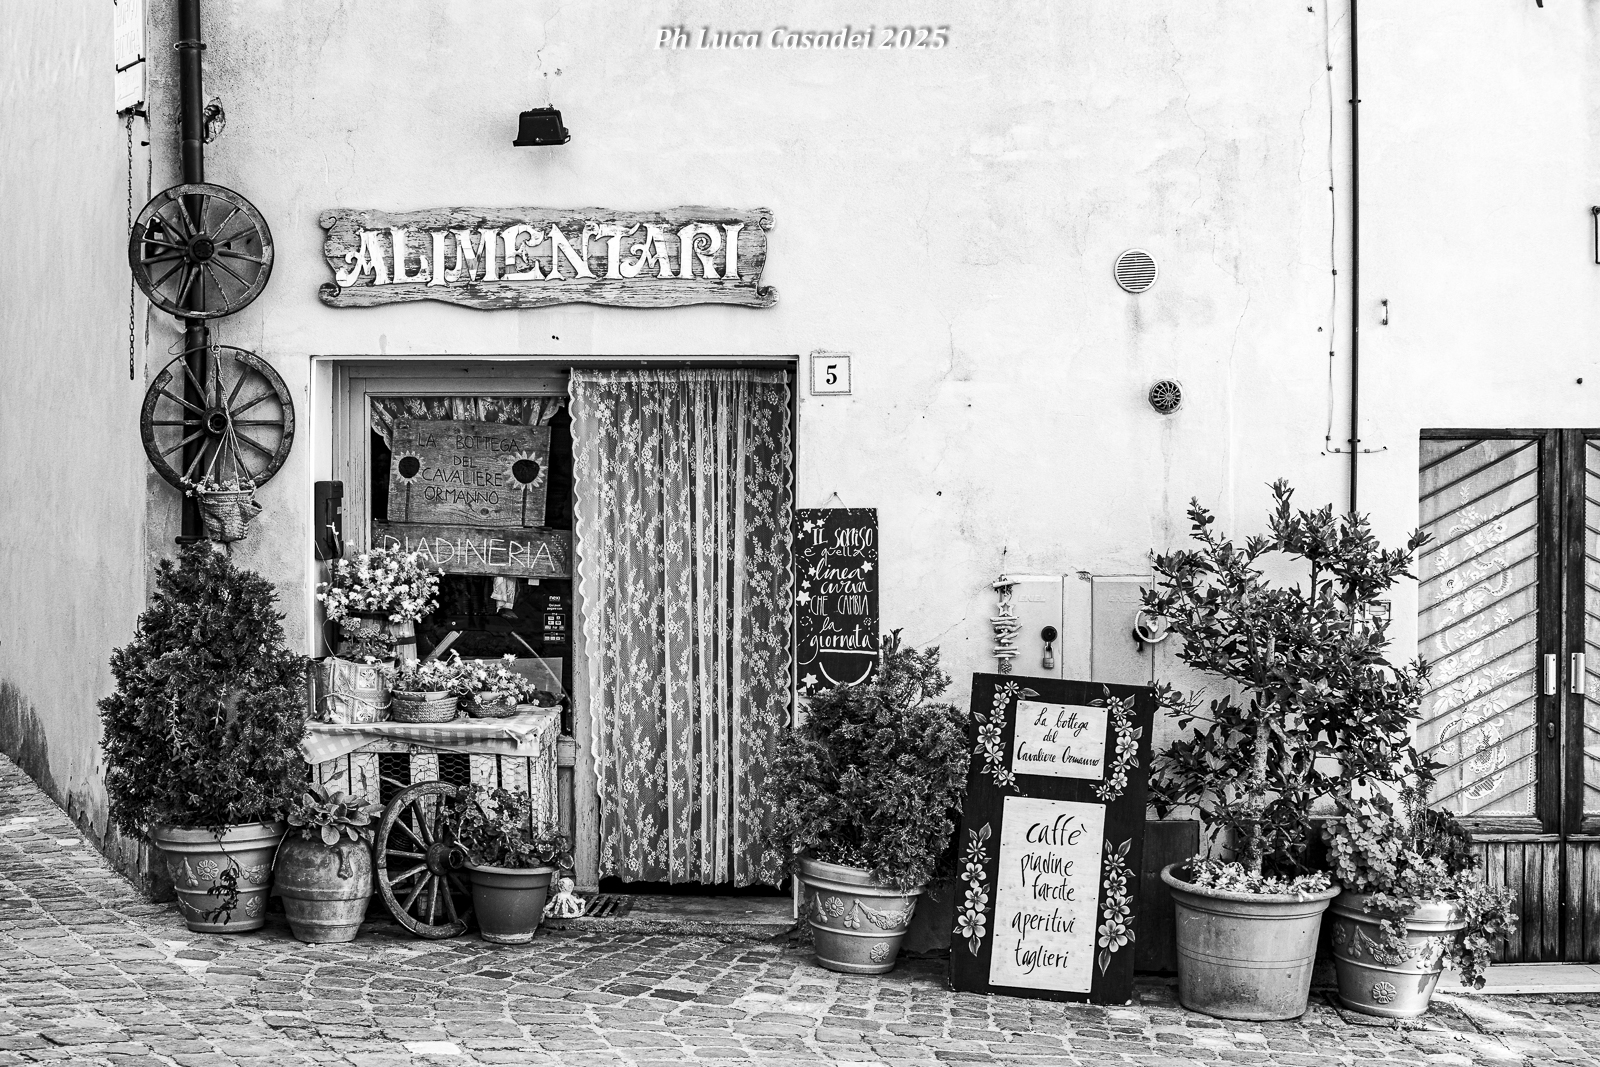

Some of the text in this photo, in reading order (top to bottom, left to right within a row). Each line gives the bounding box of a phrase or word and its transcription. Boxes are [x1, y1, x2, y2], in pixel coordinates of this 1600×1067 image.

[336, 222, 745, 287] ALIMENTARI
[826, 363, 837, 385] 5
[418, 433, 519, 452] LA BOTTEGA
[453, 456, 477, 468] DEL
[422, 468, 502, 486] CAVALIERE
[424, 486, 499, 504] ORMANNO
[813, 557, 865, 581] linea
[820, 580, 874, 595] curva
[819, 617, 842, 633] la
[798, 623, 874, 666] giornata
[1034, 707, 1089, 737] La bottega
[1043, 728, 1058, 743] del
[1026, 814, 1088, 846] caffè
[1020, 851, 1075, 888] piadine
[1031, 873, 1076, 902] farcite
[1011, 907, 1077, 941] aperitivi
[1014, 938, 1070, 976] taglieri
